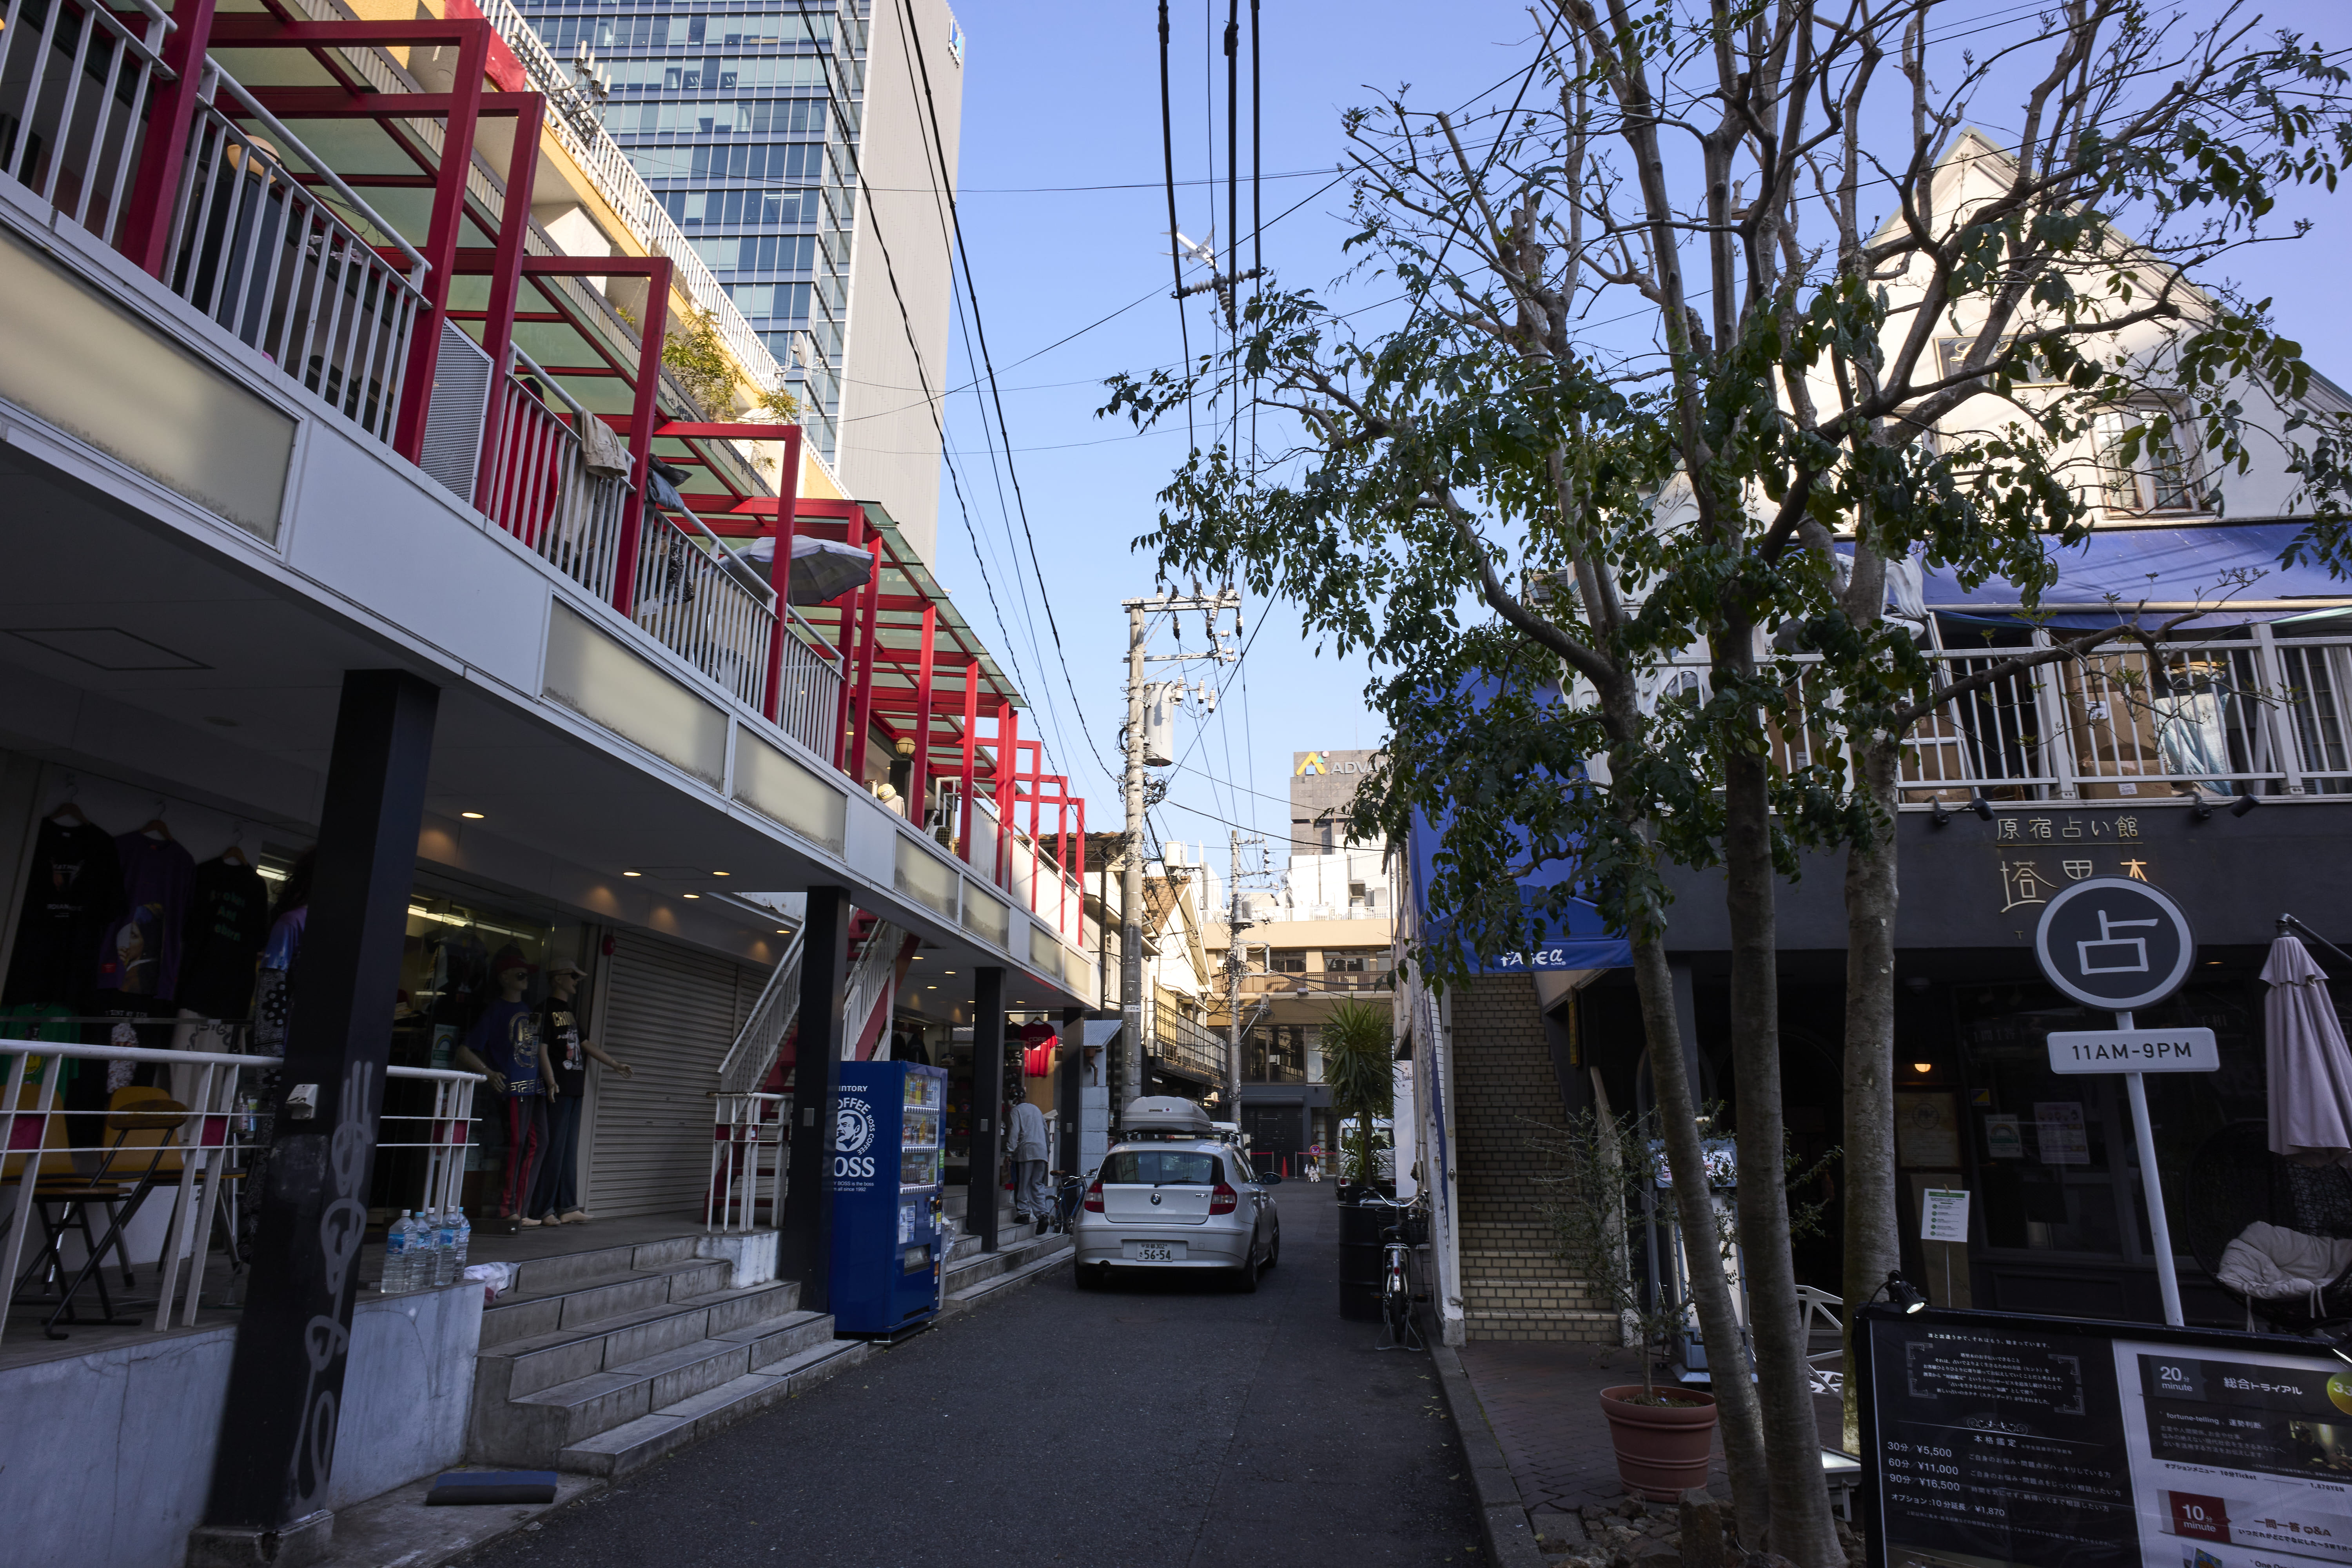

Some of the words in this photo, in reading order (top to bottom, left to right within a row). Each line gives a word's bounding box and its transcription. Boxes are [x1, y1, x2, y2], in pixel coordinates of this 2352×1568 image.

[1997, 815, 2138, 840] 原宿占い館
[2077, 909, 2158, 975] 占
[2072, 1042, 2192, 1060] 11AM-9PM
[866, 1114, 875, 1132] BOSS
[857, 1133, 875, 1156] COFFEE
[834, 1156, 875, 1178] OSS
[1144, 1250, 1171, 1260] 56-54
[2161, 1381, 2192, 1392] minute
[2223, 1376, 2303, 1396] 総合トライアル
[1973, 1434, 2017, 1448] 本格鑑定
[2183, 1521, 2216, 1533] minute
[2254, 1518, 2301, 1534] 一問一答
[2303, 1526, 2332, 1537] Q&A
